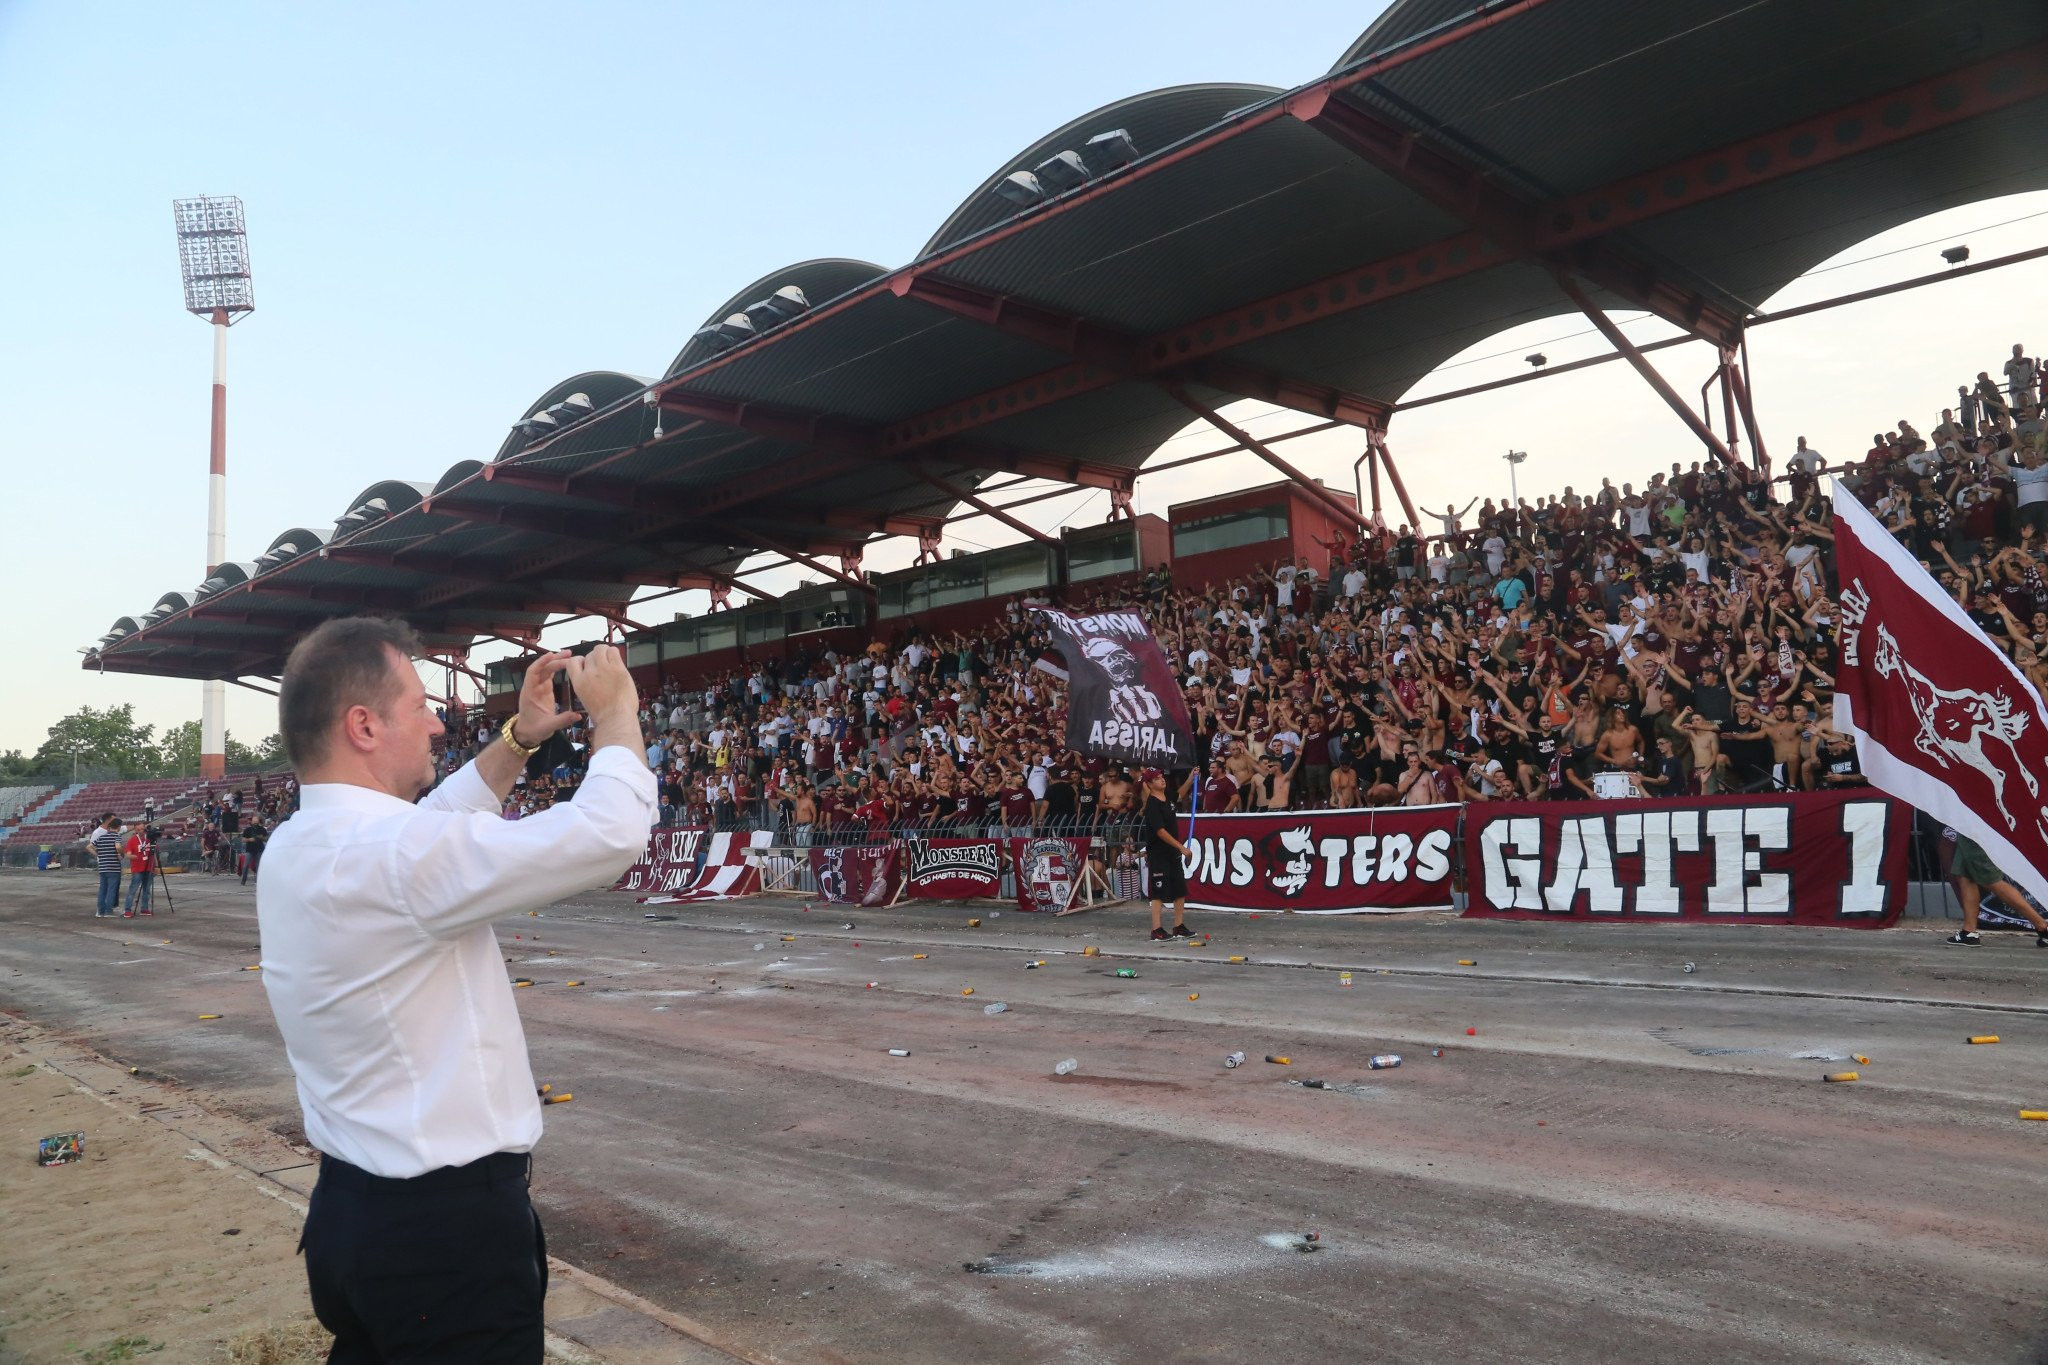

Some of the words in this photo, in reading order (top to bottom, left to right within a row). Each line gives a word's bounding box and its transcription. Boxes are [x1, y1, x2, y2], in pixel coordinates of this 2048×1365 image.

[919, 875, 932, 886] OLD
[932, 871, 957, 882] HABITS
[957, 871, 970, 879] DIE
[970, 872, 991, 884] HARD
[1480, 806, 1790, 914] GATE
[1841, 802, 1887, 913] 1
